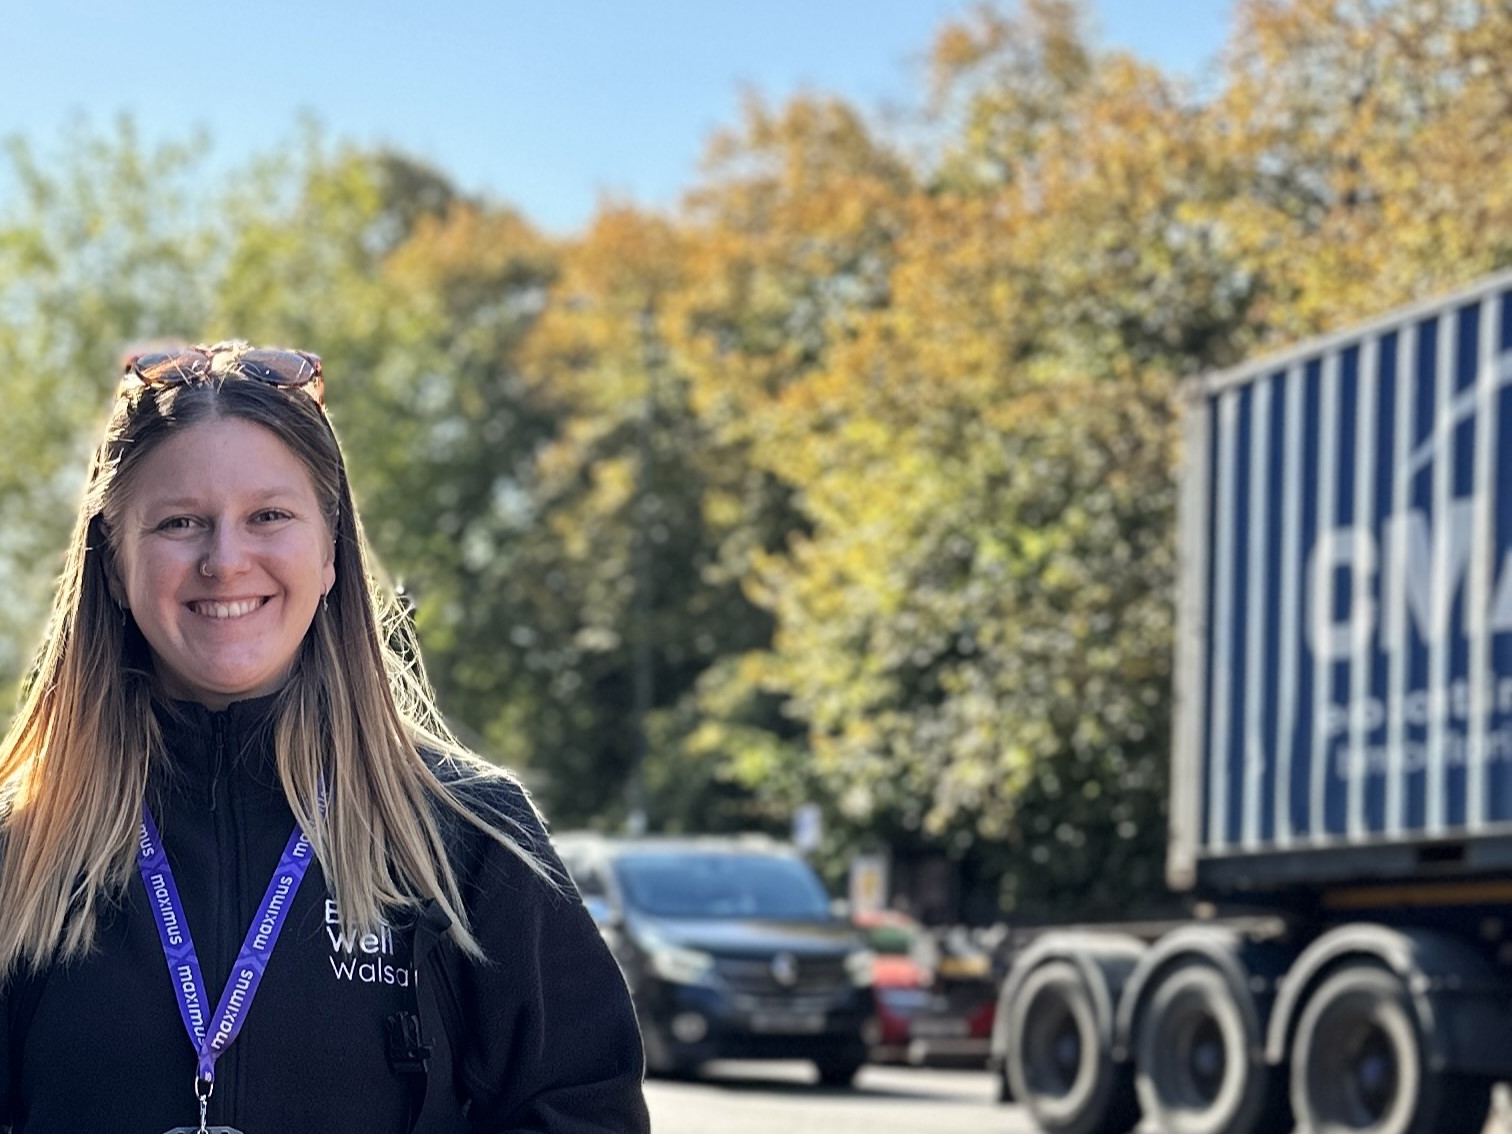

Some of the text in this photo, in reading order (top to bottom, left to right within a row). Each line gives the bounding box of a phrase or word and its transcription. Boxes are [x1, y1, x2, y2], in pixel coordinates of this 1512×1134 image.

[1305, 495, 1512, 663] CM
[150, 873, 183, 945] maximus
[252, 876, 293, 950] maximus
[210, 968, 254, 1050] maximus
